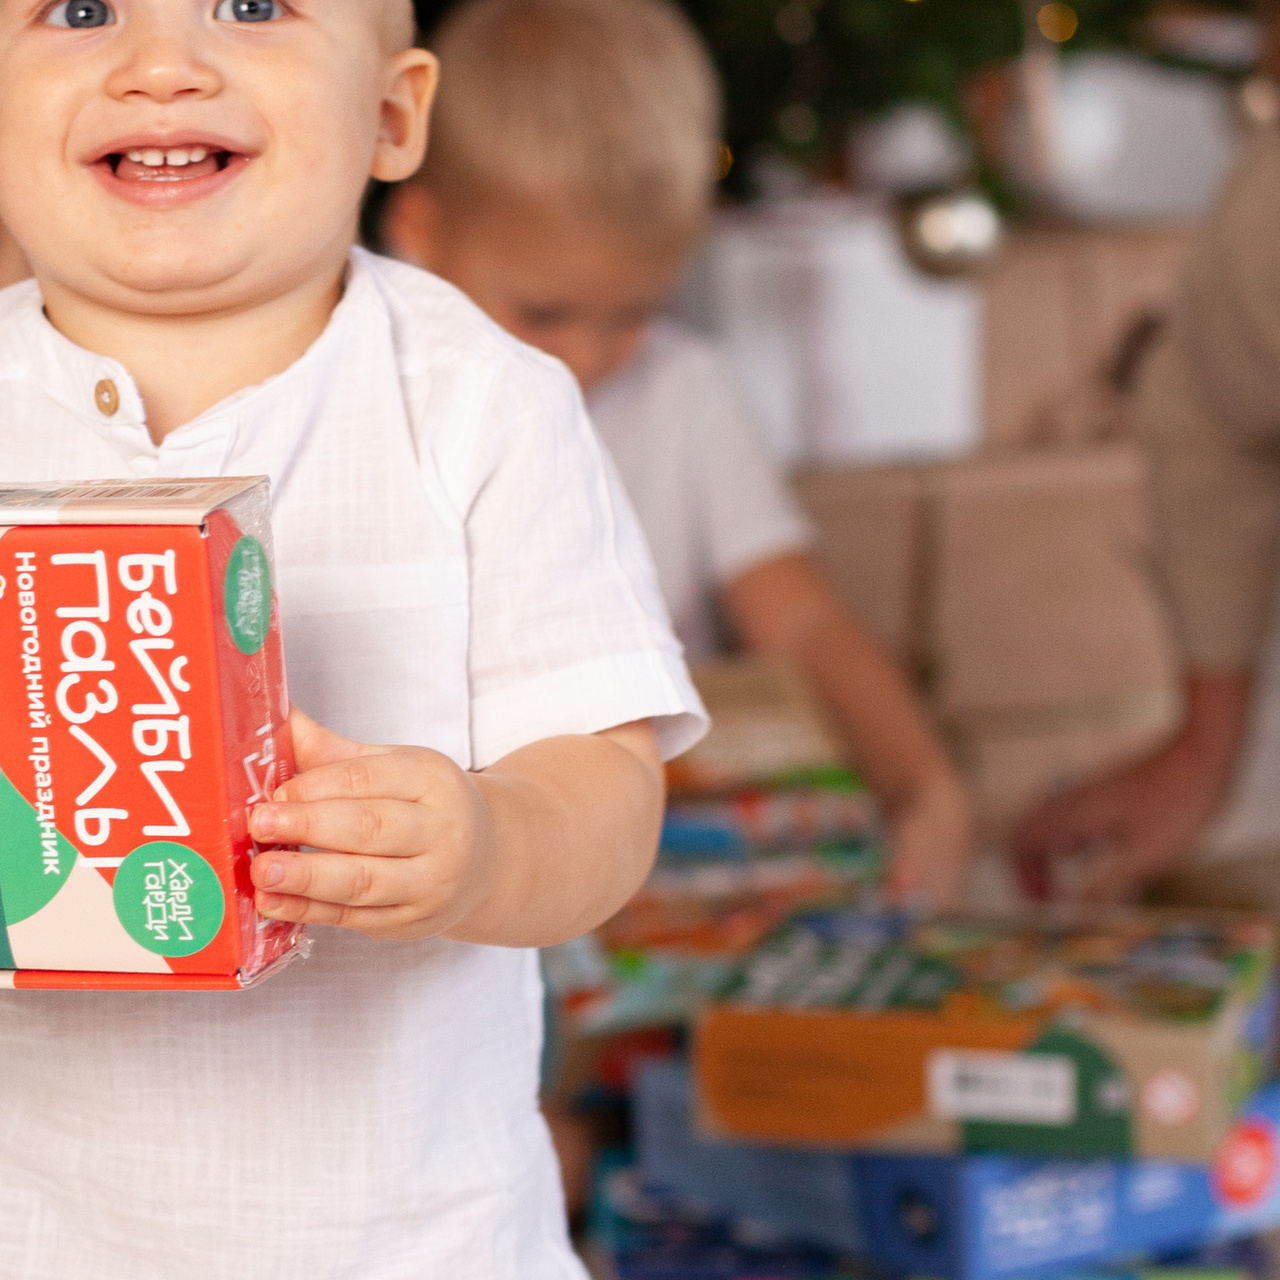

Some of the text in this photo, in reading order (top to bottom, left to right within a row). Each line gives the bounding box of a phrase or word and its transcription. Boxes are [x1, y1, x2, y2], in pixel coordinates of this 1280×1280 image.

[15, 551, 61, 876] Новогодний праздник
[118, 549, 192, 837] Бейби
[141, 860, 170, 941] Гарди
[165, 858, 194, 941] Харди
